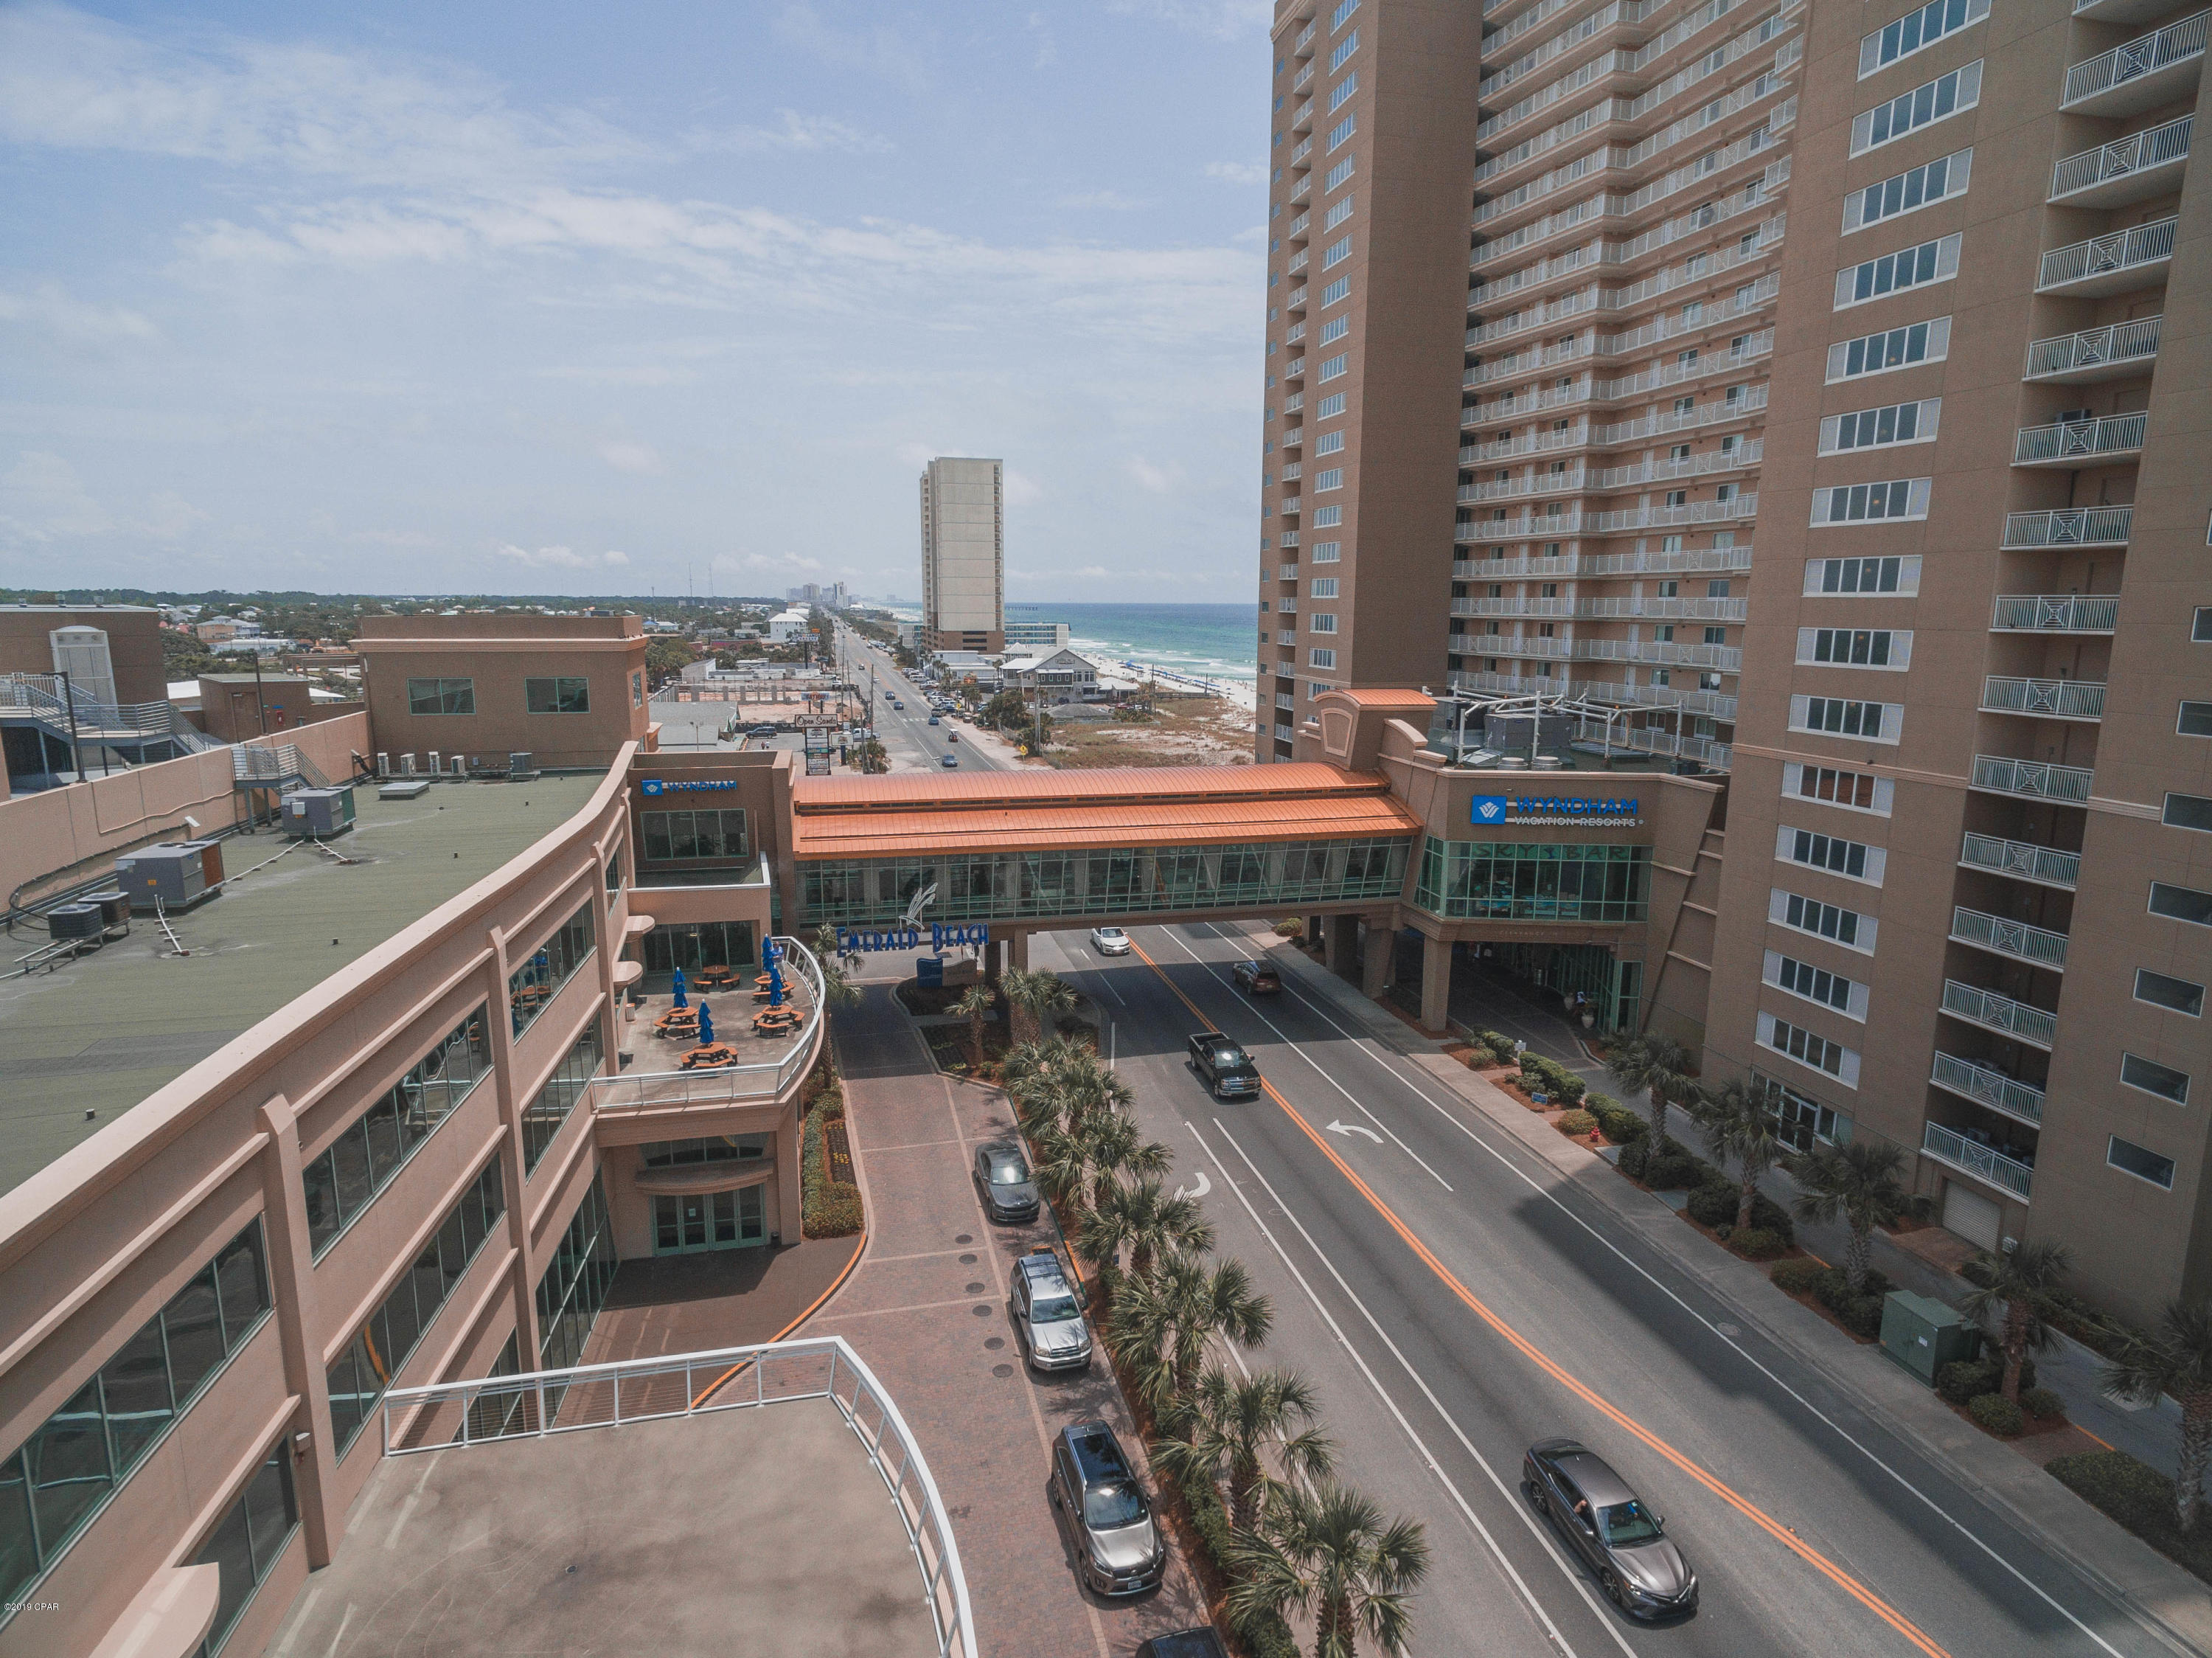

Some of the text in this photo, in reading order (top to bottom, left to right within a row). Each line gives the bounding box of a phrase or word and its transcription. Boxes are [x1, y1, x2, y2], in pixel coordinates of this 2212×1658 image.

[797, 715, 836, 726] Open Sands
[668, 780, 737, 791] WYNDHAM
[1515, 797, 1638, 815] WYNDHAM
[1514, 816, 1635, 827] VACATION RESORTS
[1474, 844, 1629, 859] SKY BAR
[836, 923, 989, 957] EMERALD BEACH
